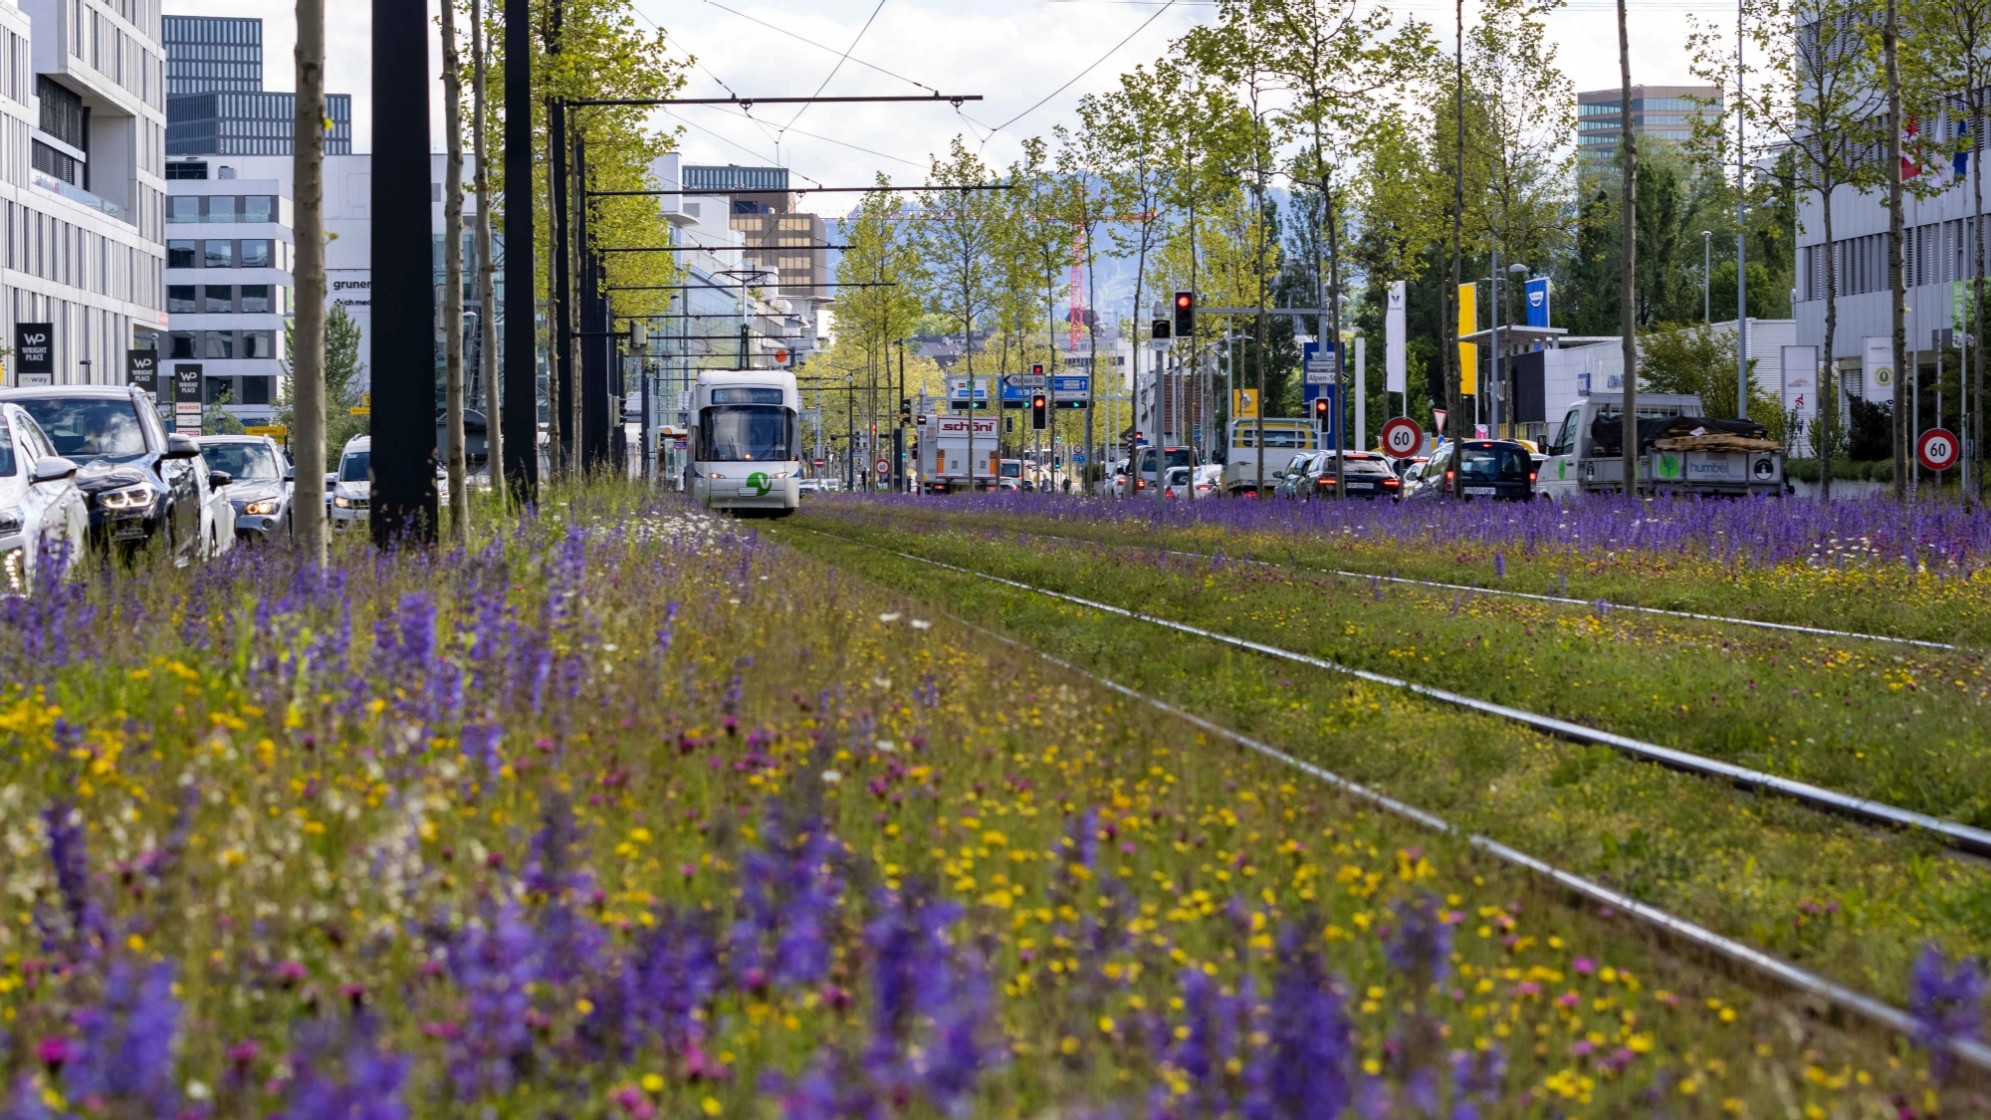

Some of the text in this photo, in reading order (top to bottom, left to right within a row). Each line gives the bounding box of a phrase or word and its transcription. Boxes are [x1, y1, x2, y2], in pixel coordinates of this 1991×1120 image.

[333, 281, 371, 290] gruner
[24, 333, 46, 345] WP
[133, 358, 152, 368] WP
[180, 372, 197, 381] WP
[1309, 374, 1336, 382] Alpen-St
[1394, 431, 1409, 446] 60
[1930, 442, 1946, 457] 60
[1689, 462, 1729, 474] humbel
